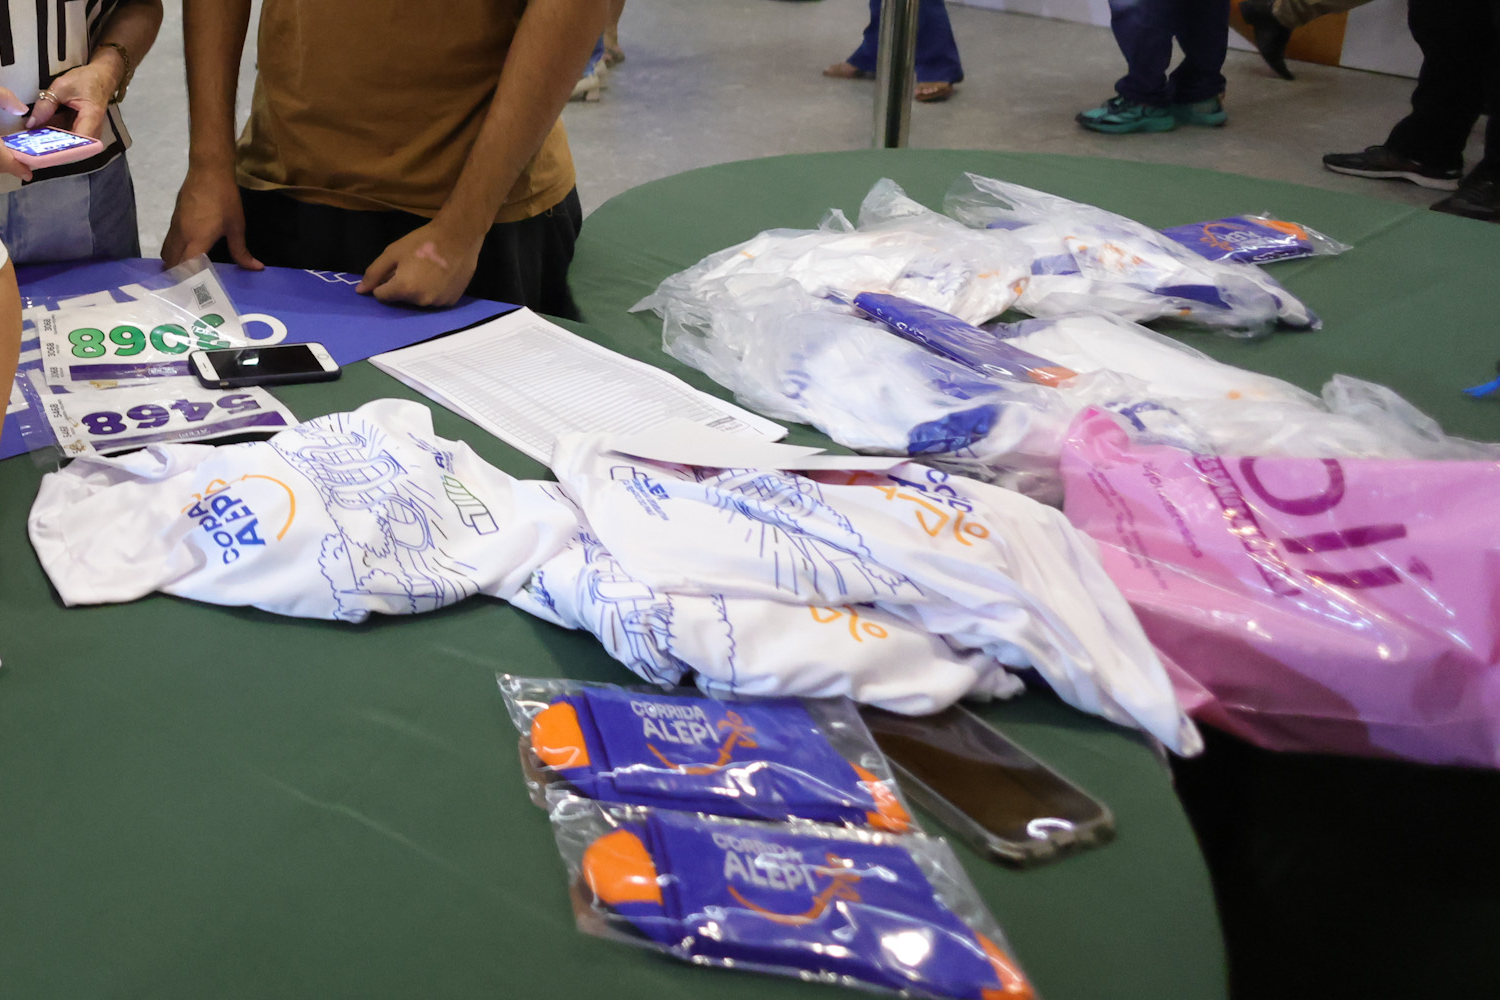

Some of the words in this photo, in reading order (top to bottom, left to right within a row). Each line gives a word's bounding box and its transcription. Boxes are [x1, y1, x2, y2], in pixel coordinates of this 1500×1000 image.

[67, 313, 231, 358] 3068
[80, 393, 262, 436] 5468
[629, 700, 708, 722] CORRIDA
[643, 717, 720, 745] ALEPI
[724, 850, 816, 892] ALEPI
